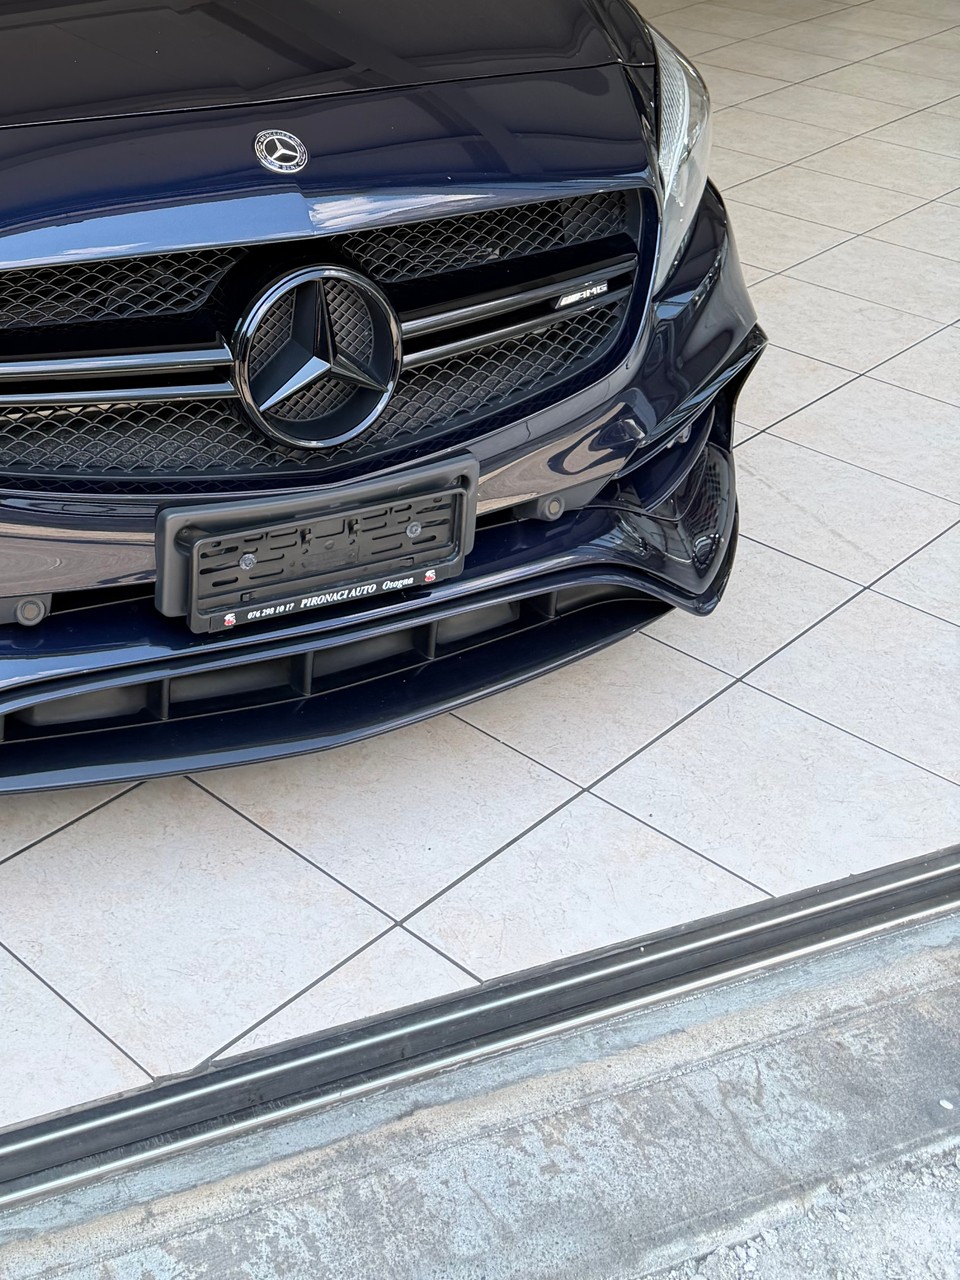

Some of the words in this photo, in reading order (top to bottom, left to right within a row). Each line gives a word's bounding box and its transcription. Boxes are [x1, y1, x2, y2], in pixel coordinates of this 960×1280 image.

[579, 283, 608, 299] AMG
[247, 609, 261, 620] 076
[261, 607, 275, 617] 298
[275, 605, 285, 614] 10
[285, 602, 295, 612] 17
[300, 589, 349, 608] PIRONACI
[349, 584, 377, 598] AUTO
[382, 577, 414, 590] Osogna
